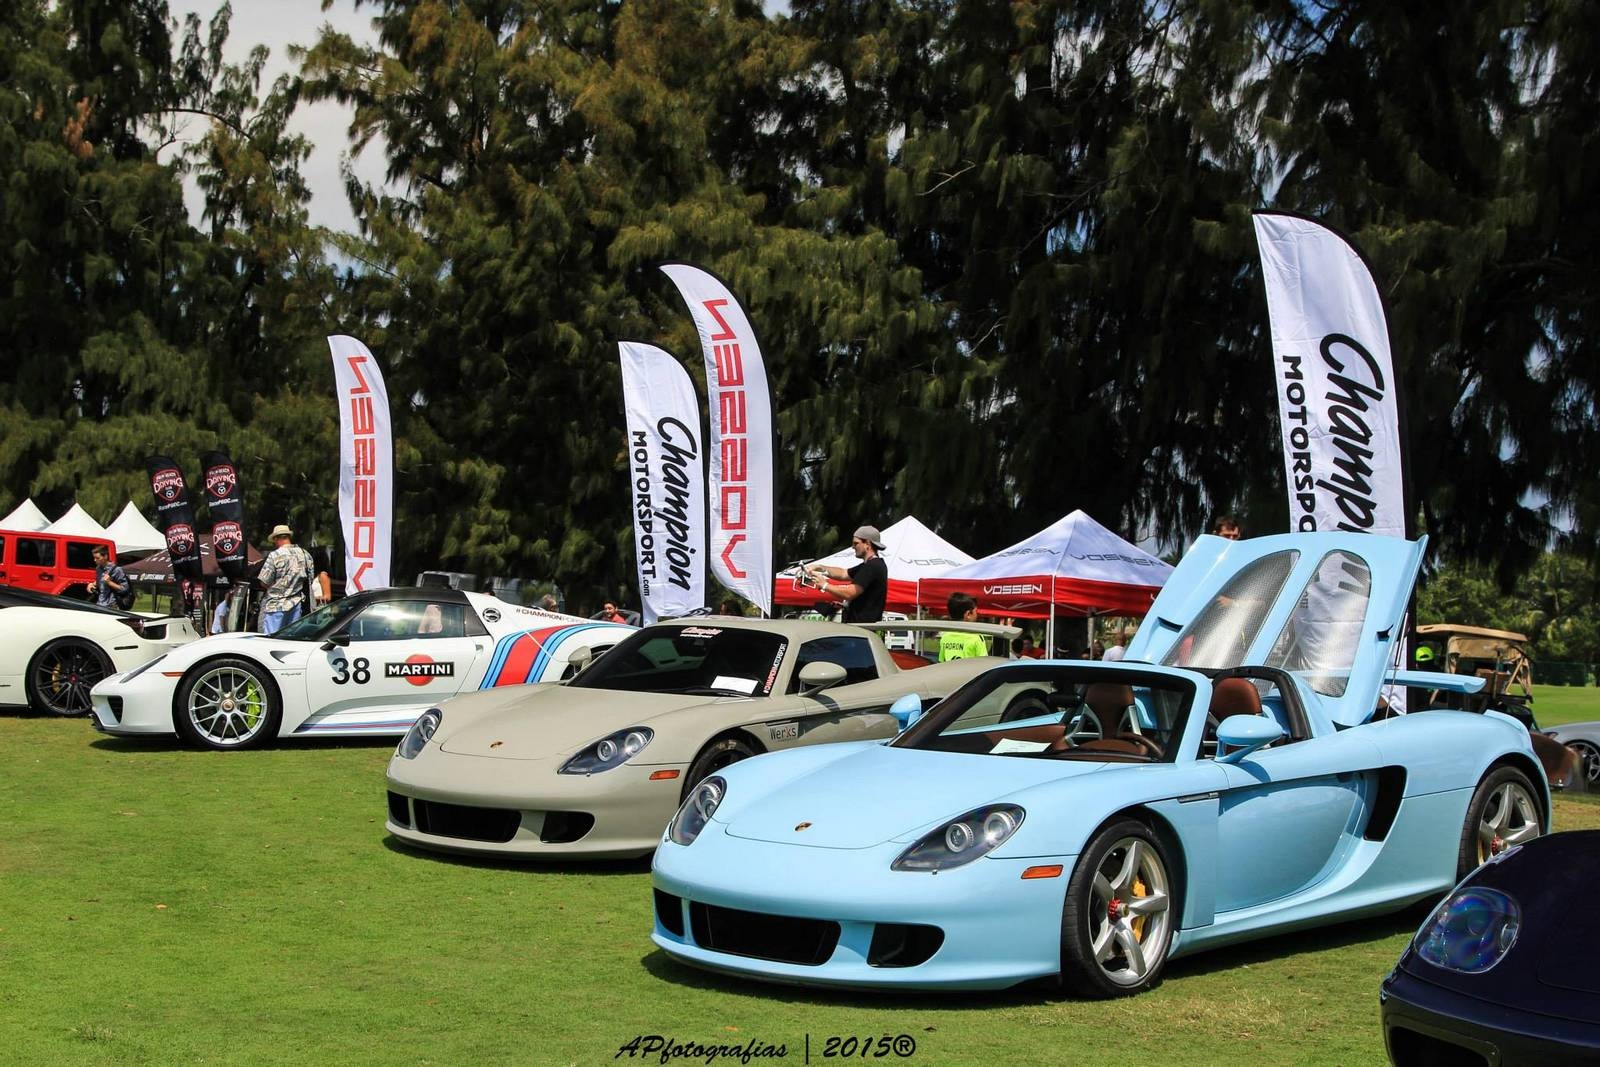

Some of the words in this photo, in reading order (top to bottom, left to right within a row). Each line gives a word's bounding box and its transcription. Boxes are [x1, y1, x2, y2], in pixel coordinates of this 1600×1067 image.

[1316, 333, 1385, 534] Champ
[1281, 355, 1317, 532] MOTORSPO
[153, 477, 184, 493] DRIVING
[206, 473, 236, 489] DRIVING
[655, 416, 698, 591] Champion
[167, 532, 195, 548] DRIVING
[212, 530, 243, 545] DRIVING
[983, 584, 1043, 595] VOSSEN
[331, 657, 371, 685] 38
[388, 664, 450, 675] MARTINI
[769, 727, 797, 740] Werks
